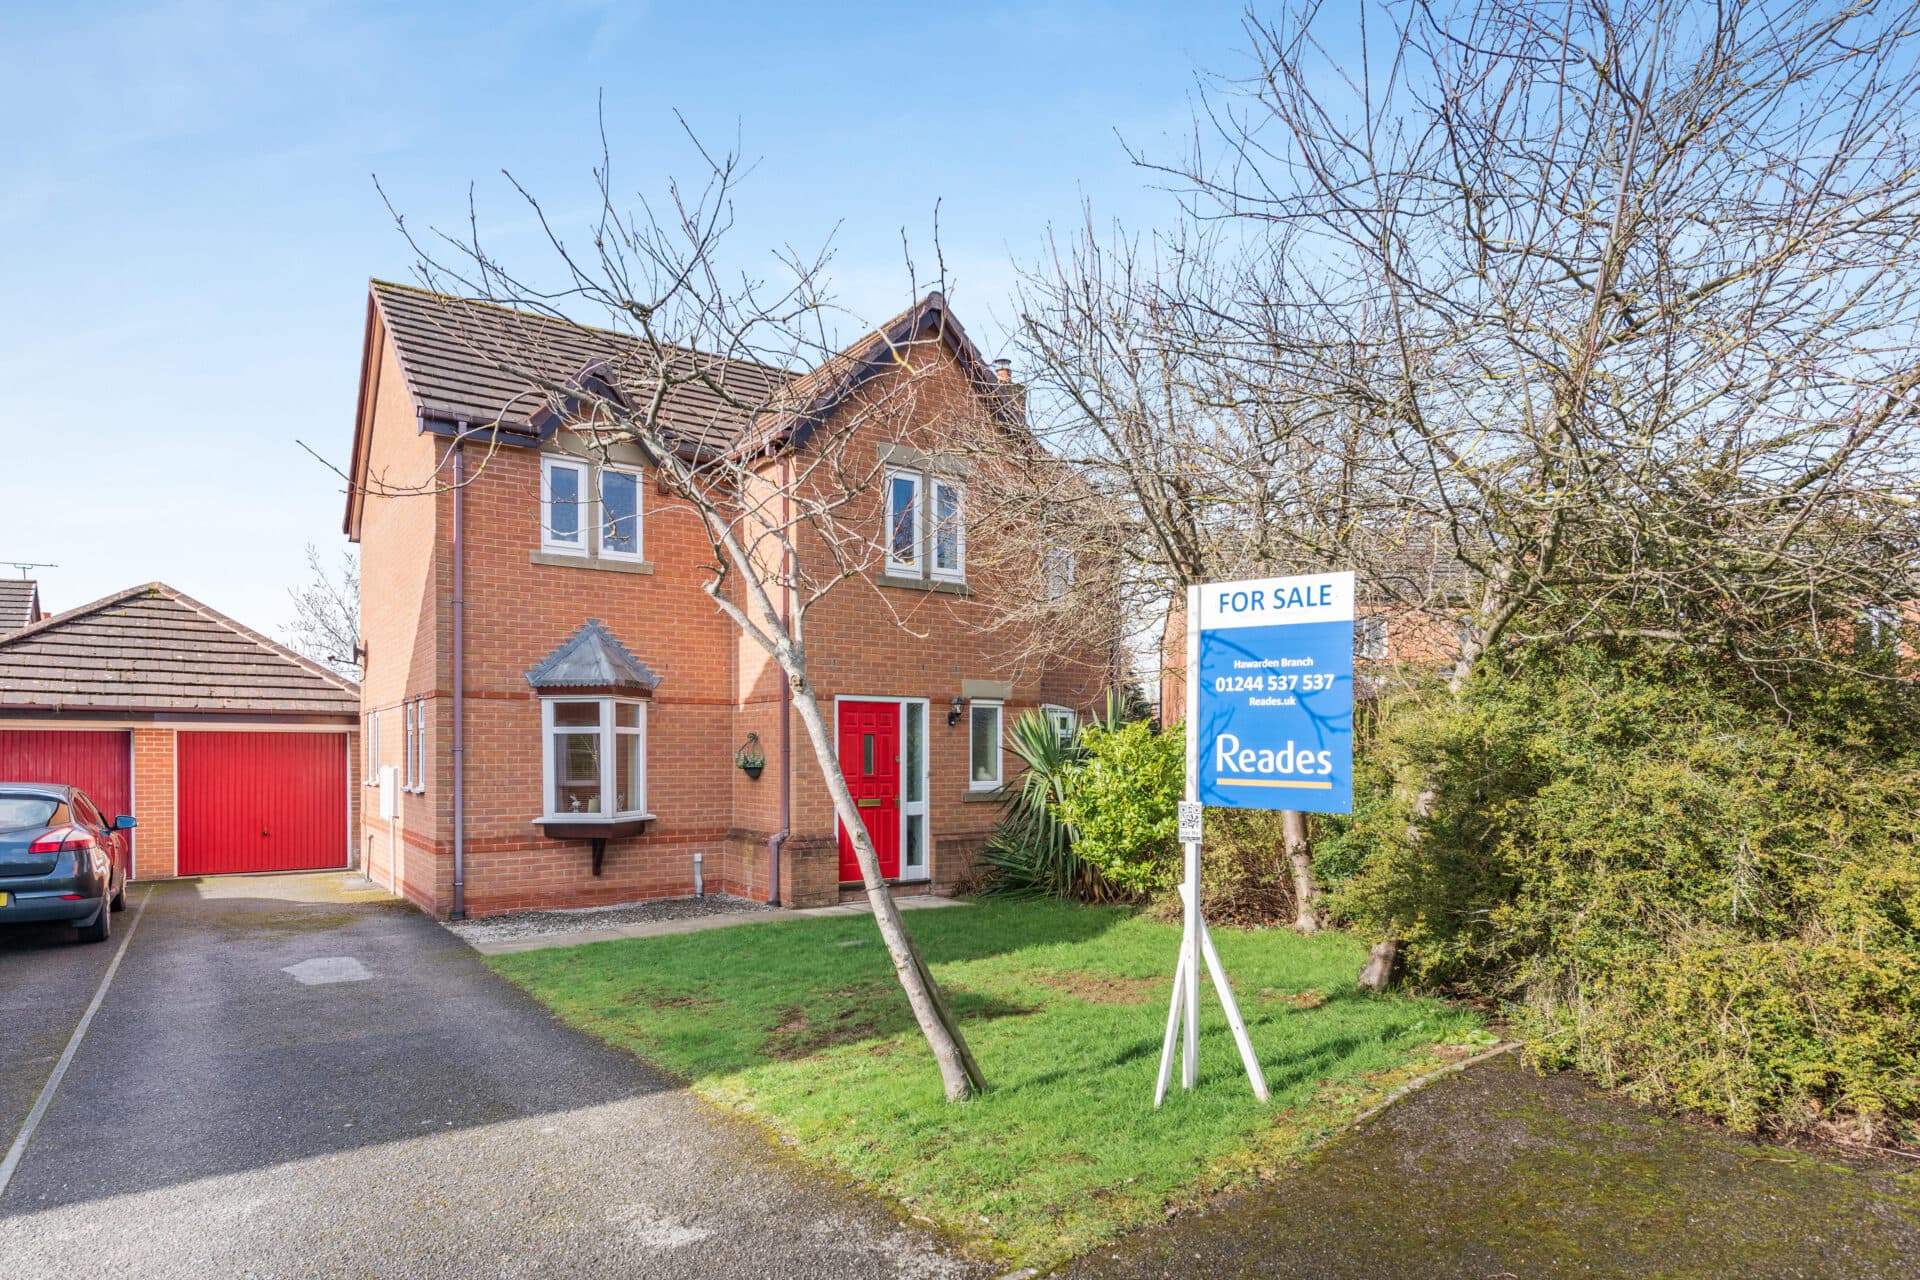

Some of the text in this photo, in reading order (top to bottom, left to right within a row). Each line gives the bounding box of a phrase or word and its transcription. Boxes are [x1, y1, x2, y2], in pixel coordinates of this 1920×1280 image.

[1219, 584, 1332, 613] FOR SALE
[1234, 657, 1313, 669] Hawarden Branch
[1215, 674, 1335, 692] 01244 537 537
[1249, 697, 1296, 706] Reades.uk
[1216, 734, 1332, 774] Reades
